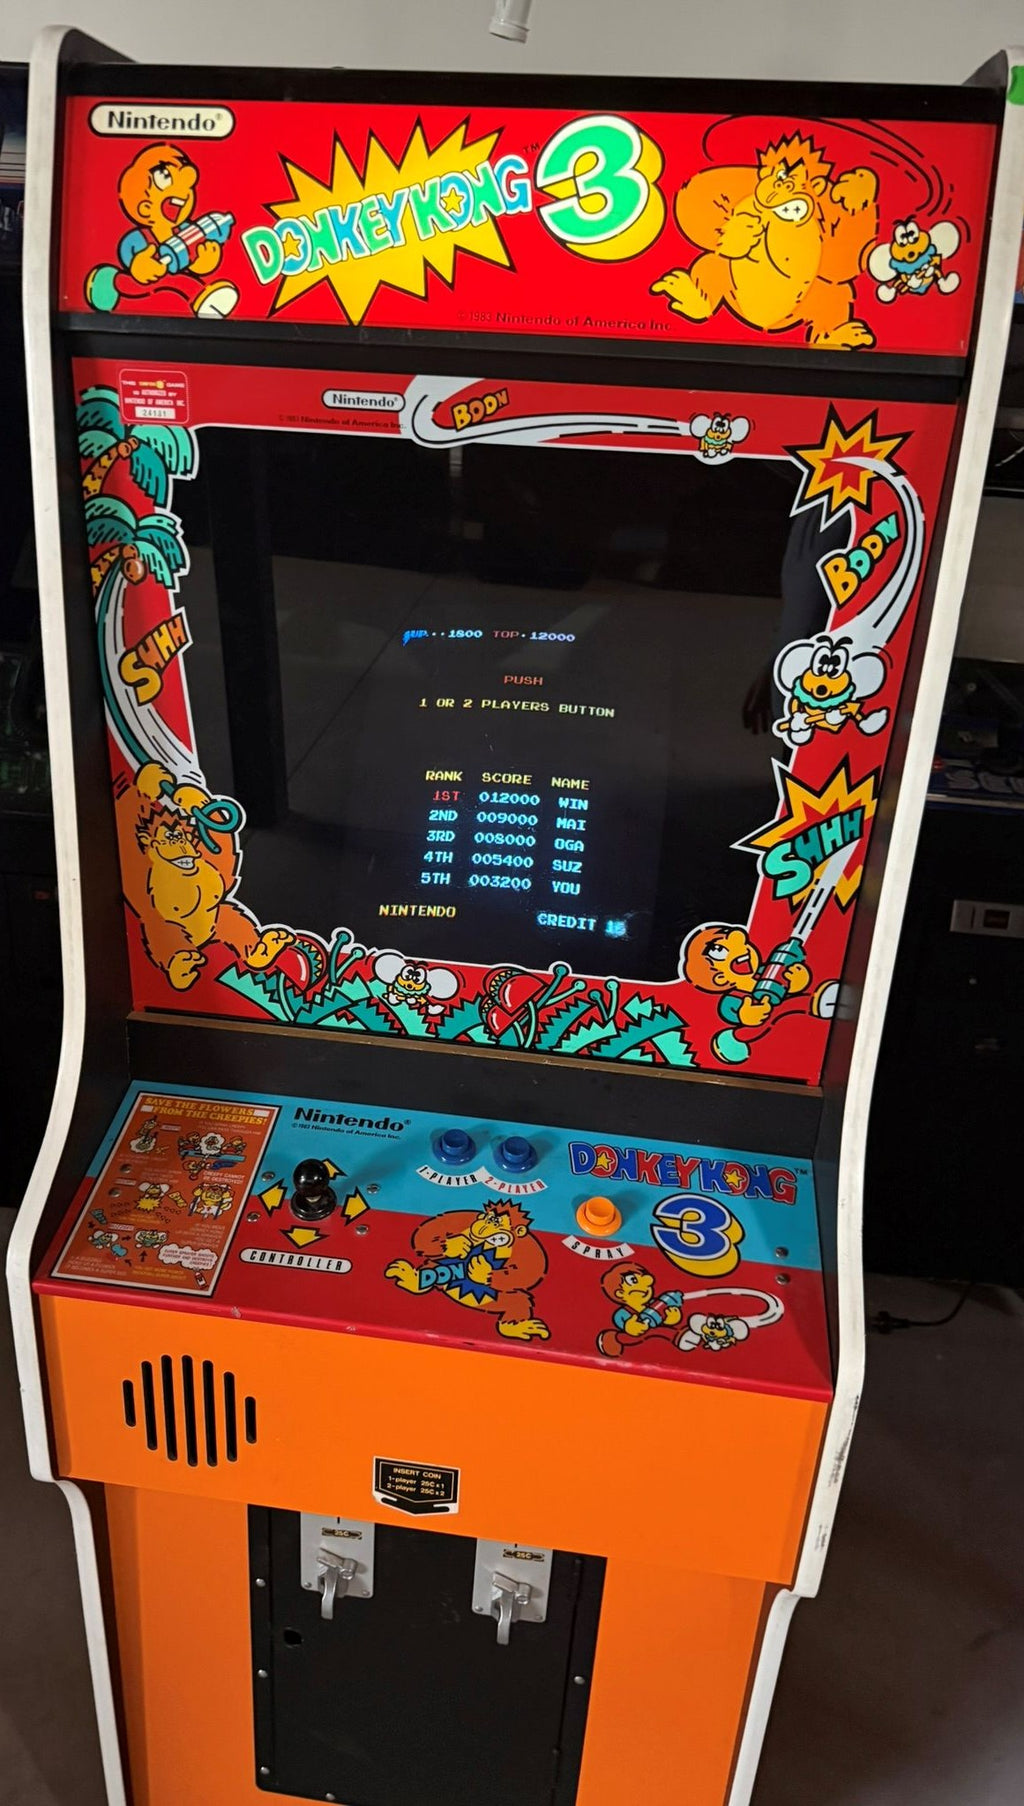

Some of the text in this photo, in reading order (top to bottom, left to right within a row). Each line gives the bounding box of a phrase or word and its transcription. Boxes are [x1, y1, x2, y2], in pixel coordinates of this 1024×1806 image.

[241, 186, 409, 285] DONKEY
[408, 153, 534, 241] KONG
[536, 114, 662, 260] 3
[470, 311, 491, 322] 1983
[495, 312, 561, 326] Nintendo
[565, 316, 579, 327] of
[583, 316, 647, 330] America
[451, 388, 509, 431] BOON
[301, 415, 340, 425] Nintendo
[352, 418, 389, 428] America
[824, 513, 899, 608] BOON
[493, 630, 519, 639] TOP
[529, 631, 576, 643] 12000
[118, 612, 189, 706] SHHH
[504, 675, 544, 686] PUSH
[419, 698, 615, 718] 1 OR 2 PLAYERS BUTTON
[425, 770, 590, 791] RANK SCORE NAME
[433, 791, 589, 811] 1ST 012000 WIN
[429, 810, 587, 832] 2ND 009000 MAI
[426, 830, 585, 853] 3RD 008000 OGA
[762, 805, 866, 899] SHHH
[423, 851, 583, 874] 4TH 005400 SUZ
[421, 872, 581, 896] 5TH 003200 YOU
[379, 905, 457, 919] NINTENDO
[537, 912, 597, 931] CREDIT
[144, 1097, 254, 1116] SAVE THE FLOWERS
[152, 1106, 267, 1126] FROM THE CREEPIES!
[312, 1124, 344, 1133] Nintendo
[355, 1130, 386, 1138] America
[569, 1141, 700, 1189] DONKEY
[700, 1159, 798, 1205] KONG
[650, 1193, 743, 1275] 3
[249, 1250, 343, 1271] CONTROLLER
[571, 1241, 624, 1259] SPRAY
[418, 1257, 466, 1289] DON
[393, 1467, 441, 1480] INSERT COIN
